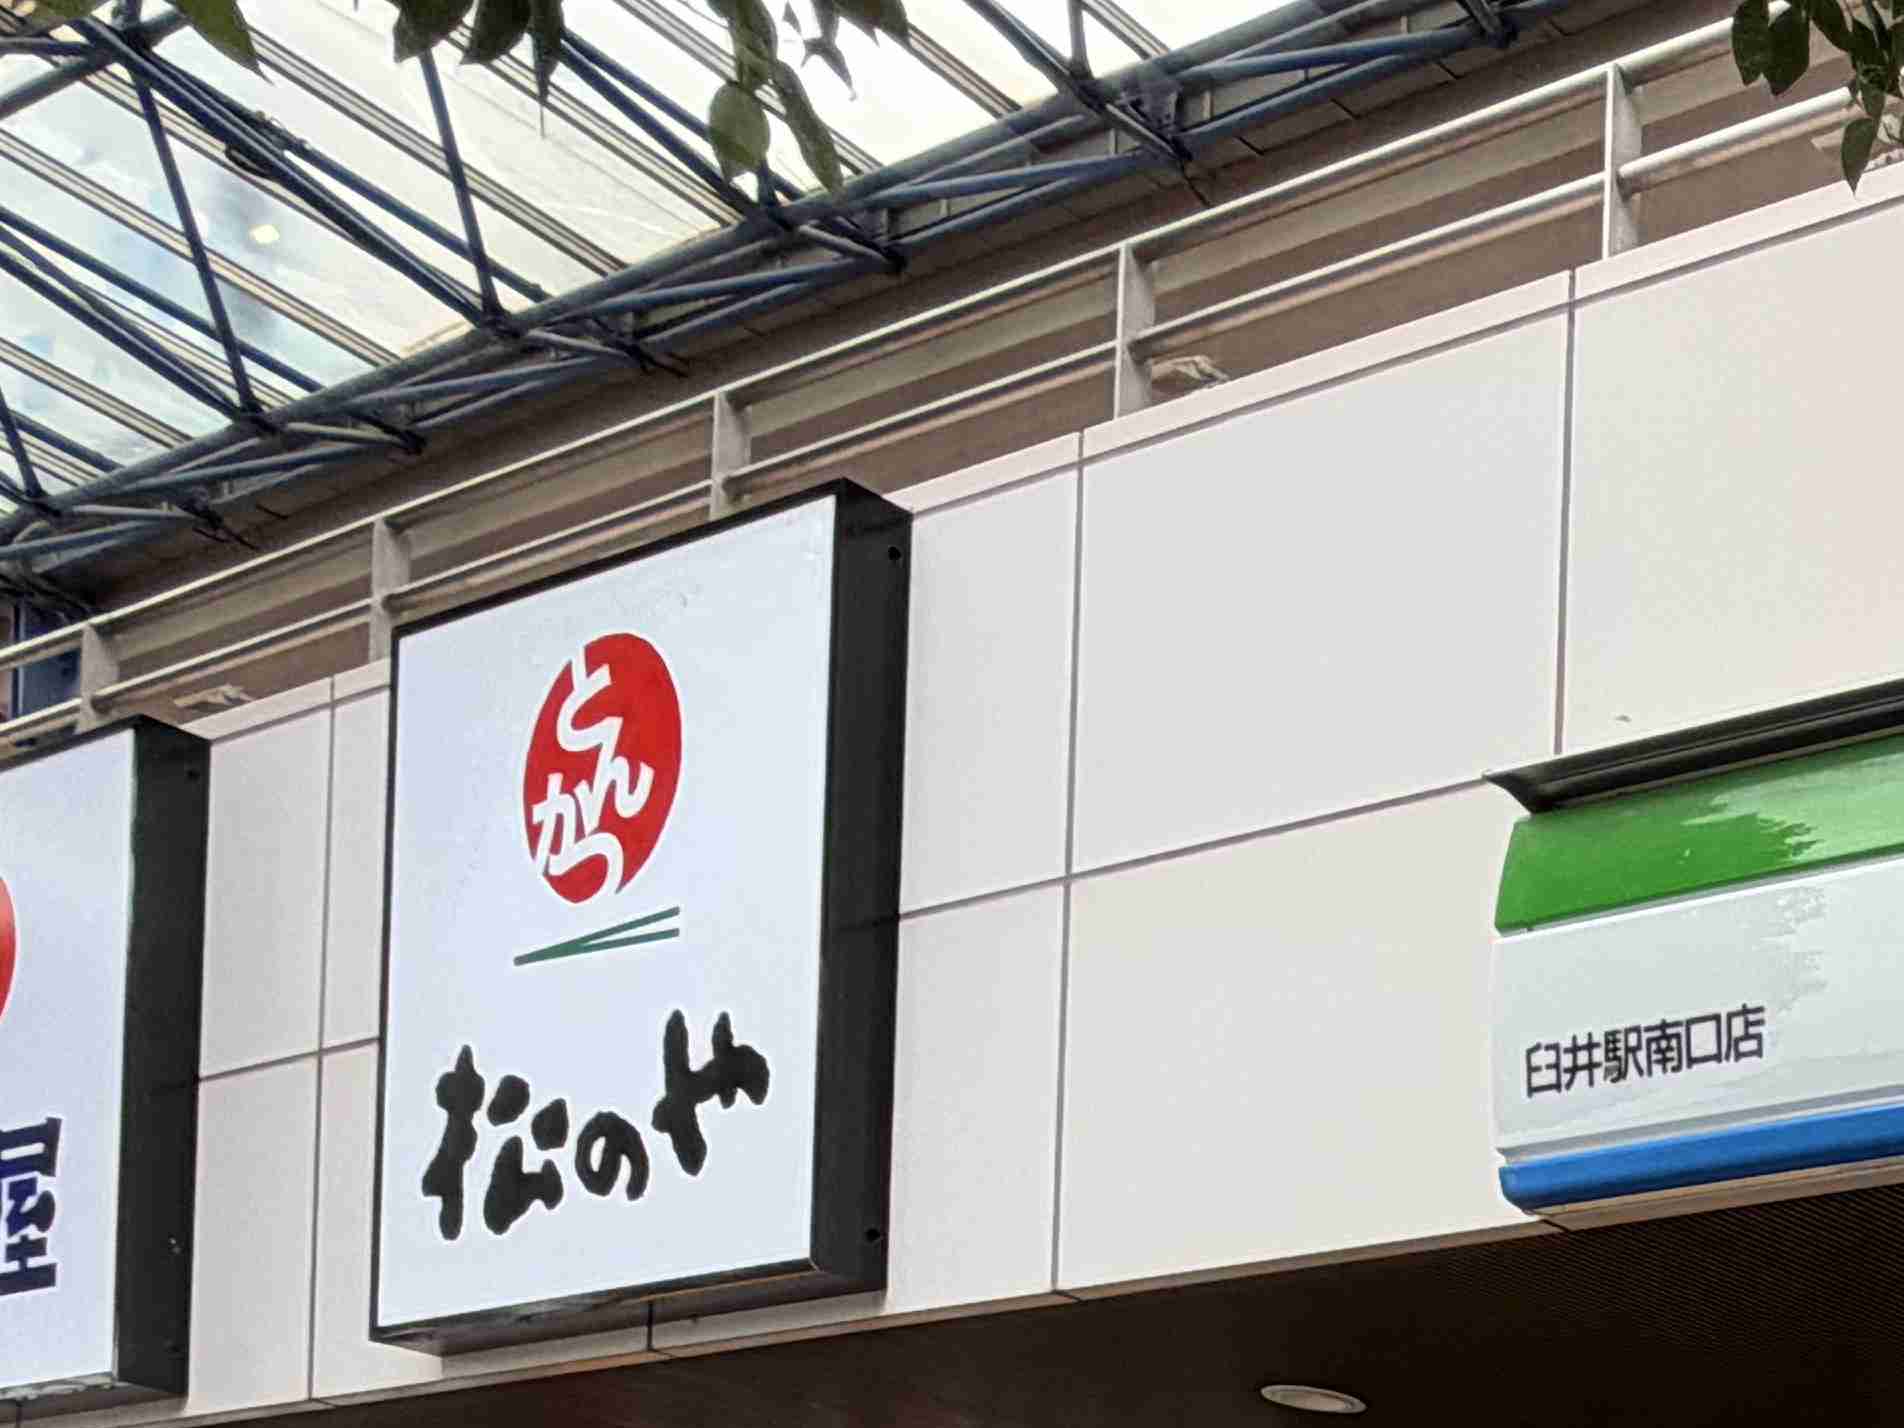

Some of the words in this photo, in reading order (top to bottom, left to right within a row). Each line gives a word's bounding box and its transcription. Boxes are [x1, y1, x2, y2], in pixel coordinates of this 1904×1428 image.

[421, 1008, 770, 1241] 松のや
[1525, 1003, 1766, 1099] 臼井駅南口店
